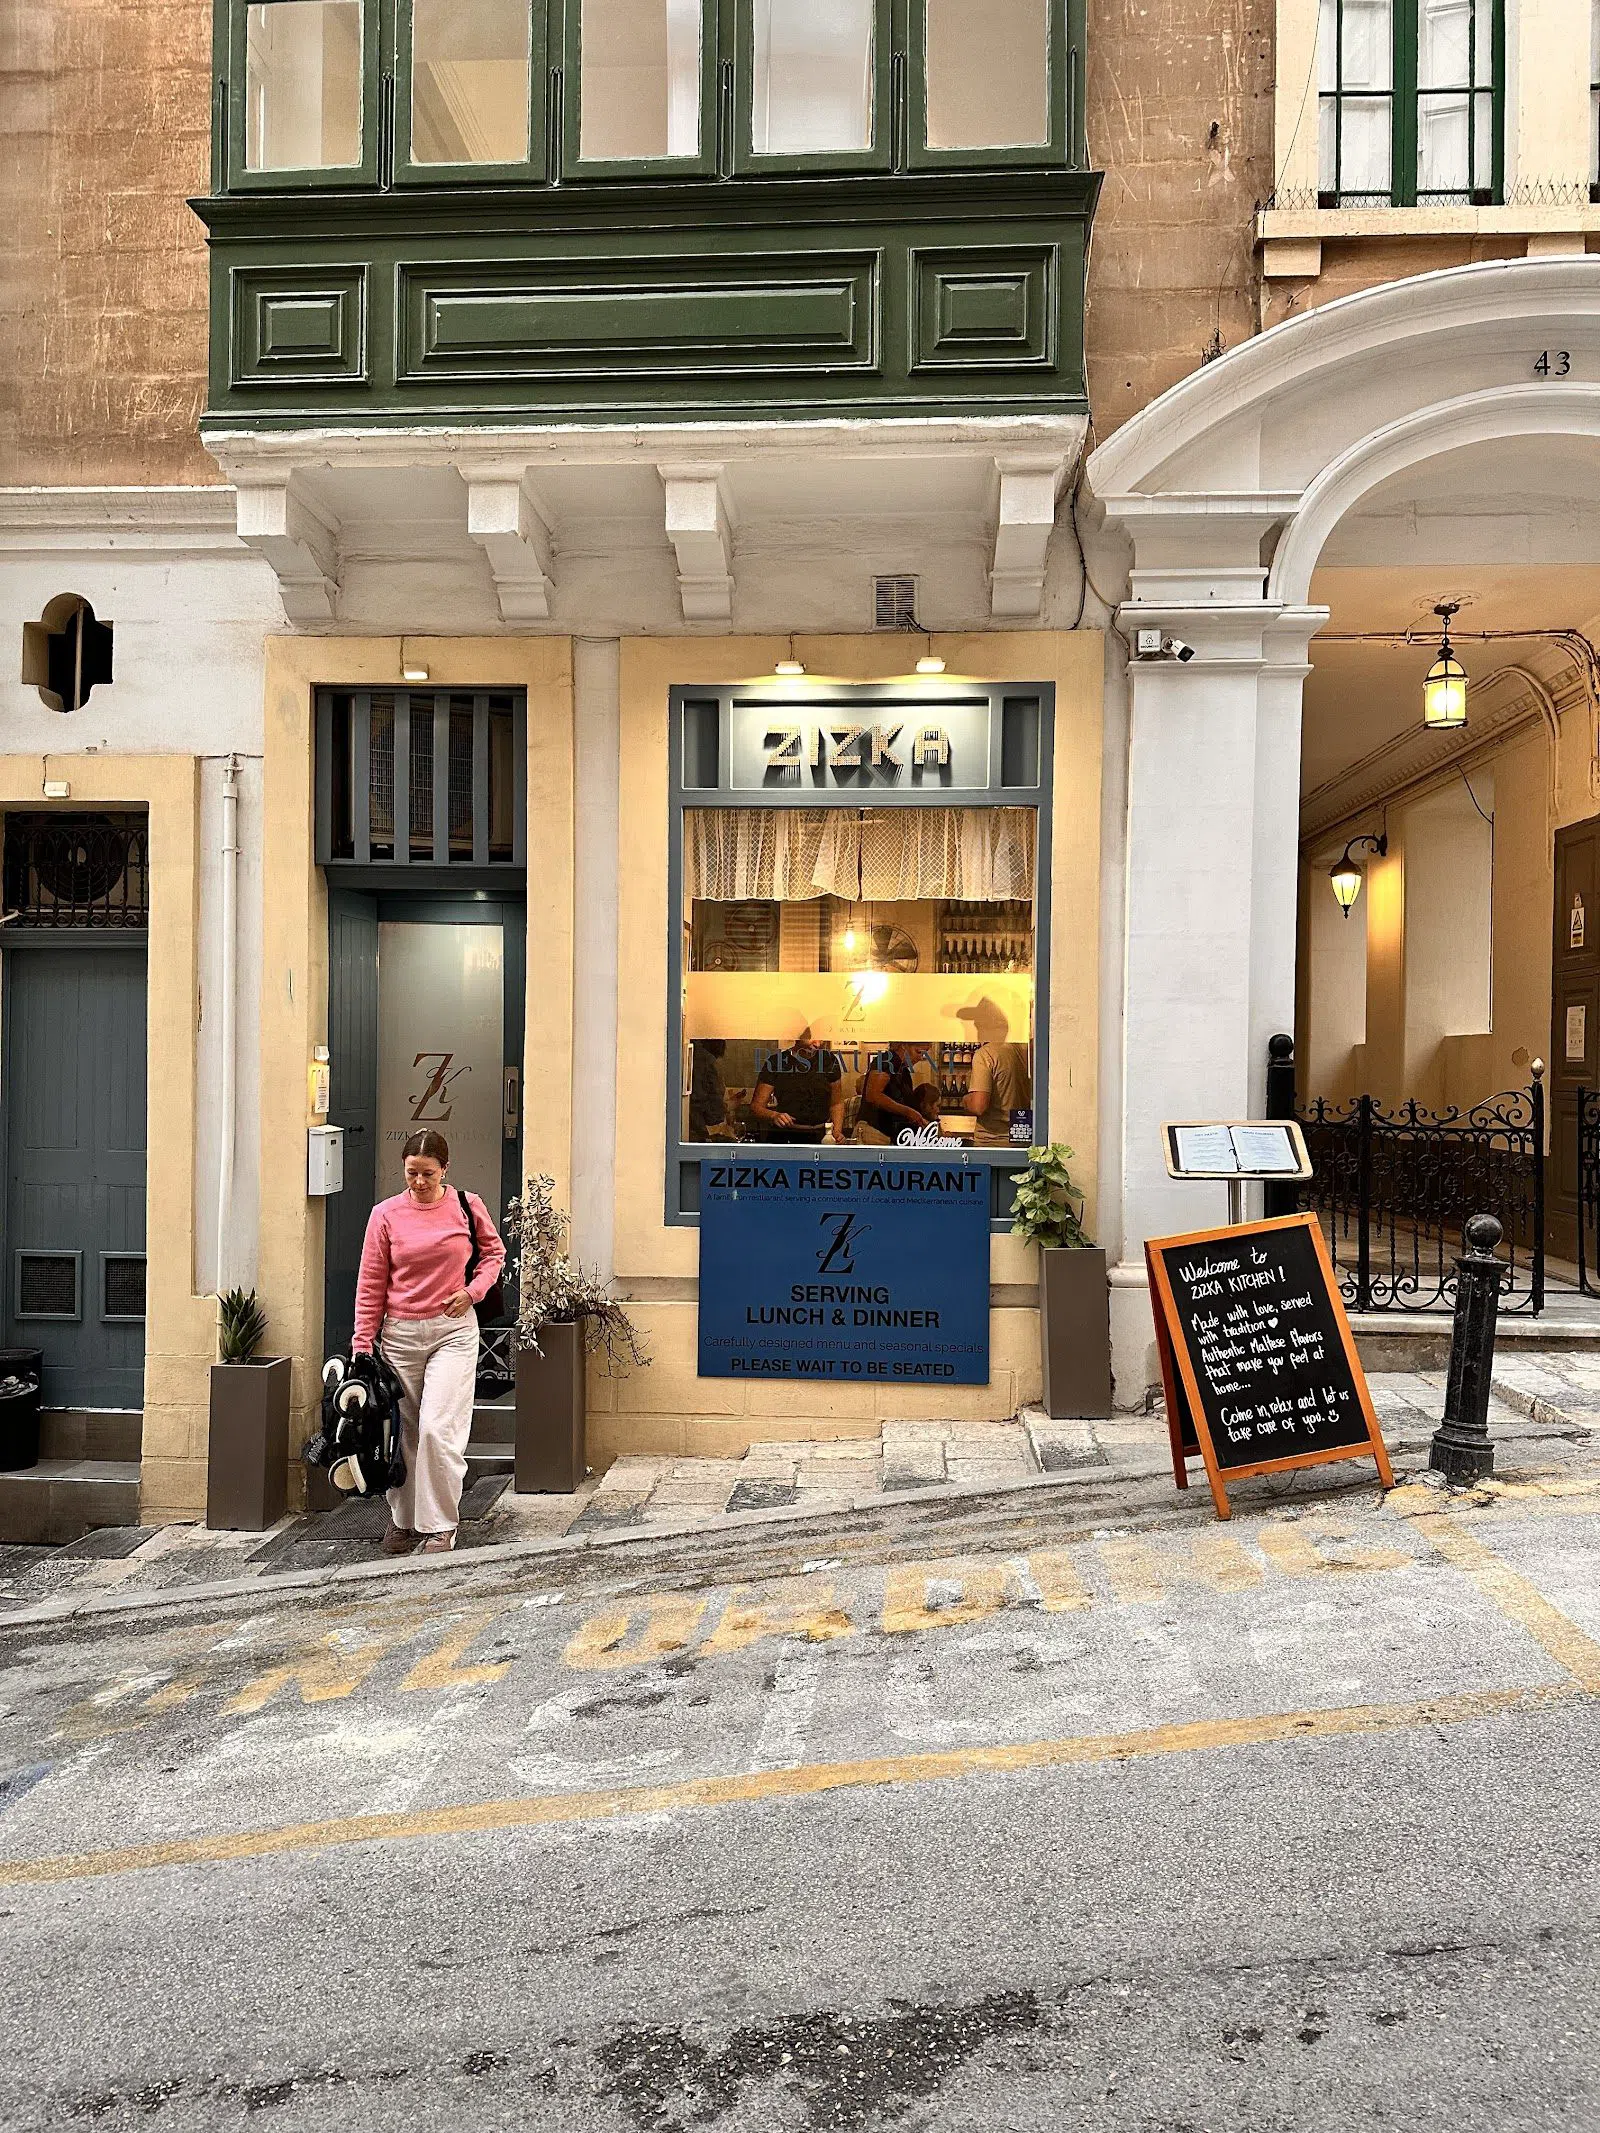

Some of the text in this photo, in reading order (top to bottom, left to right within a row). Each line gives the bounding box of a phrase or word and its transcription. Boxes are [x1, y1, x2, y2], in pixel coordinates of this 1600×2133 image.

[1533, 350, 1571, 376] 43
[767, 723, 949, 767] ZIZKA
[753, 1046, 957, 1074] RESTAURANT
[896, 1120, 963, 1148] Welcome
[709, 1167, 982, 1193] ZIZKA RESTAURANT
[1179, 1246, 1268, 1283] Welcome to
[790, 1284, 889, 1305] SERVING
[1191, 1280, 1224, 1300] ZIZKA
[1228, 1268, 1276, 1293] KITCHEN
[746, 1306, 940, 1329] LUNCH & DINNER
[1191, 1291, 1314, 1333] Made with love, served
[704, 1335, 984, 1356] Carefully designed menu and seasonal specials
[1198, 1320, 1267, 1346] with tradition
[1201, 1340, 1246, 1363] Authentic
[1250, 1333, 1287, 1354] Maltese
[731, 1358, 955, 1377] PLEASE WAIT TO BE SEATED
[1205, 1344, 1325, 1381] that make you feel at
[1211, 1380, 1252, 1396] home...
[1220, 1405, 1254, 1427] Come
[1298, 1387, 1317, 1409] and
[1322, 1385, 1337, 1405] let
[1339, 1389, 1350, 1401] us
[1227, 1411, 1326, 1443] take care of you.
